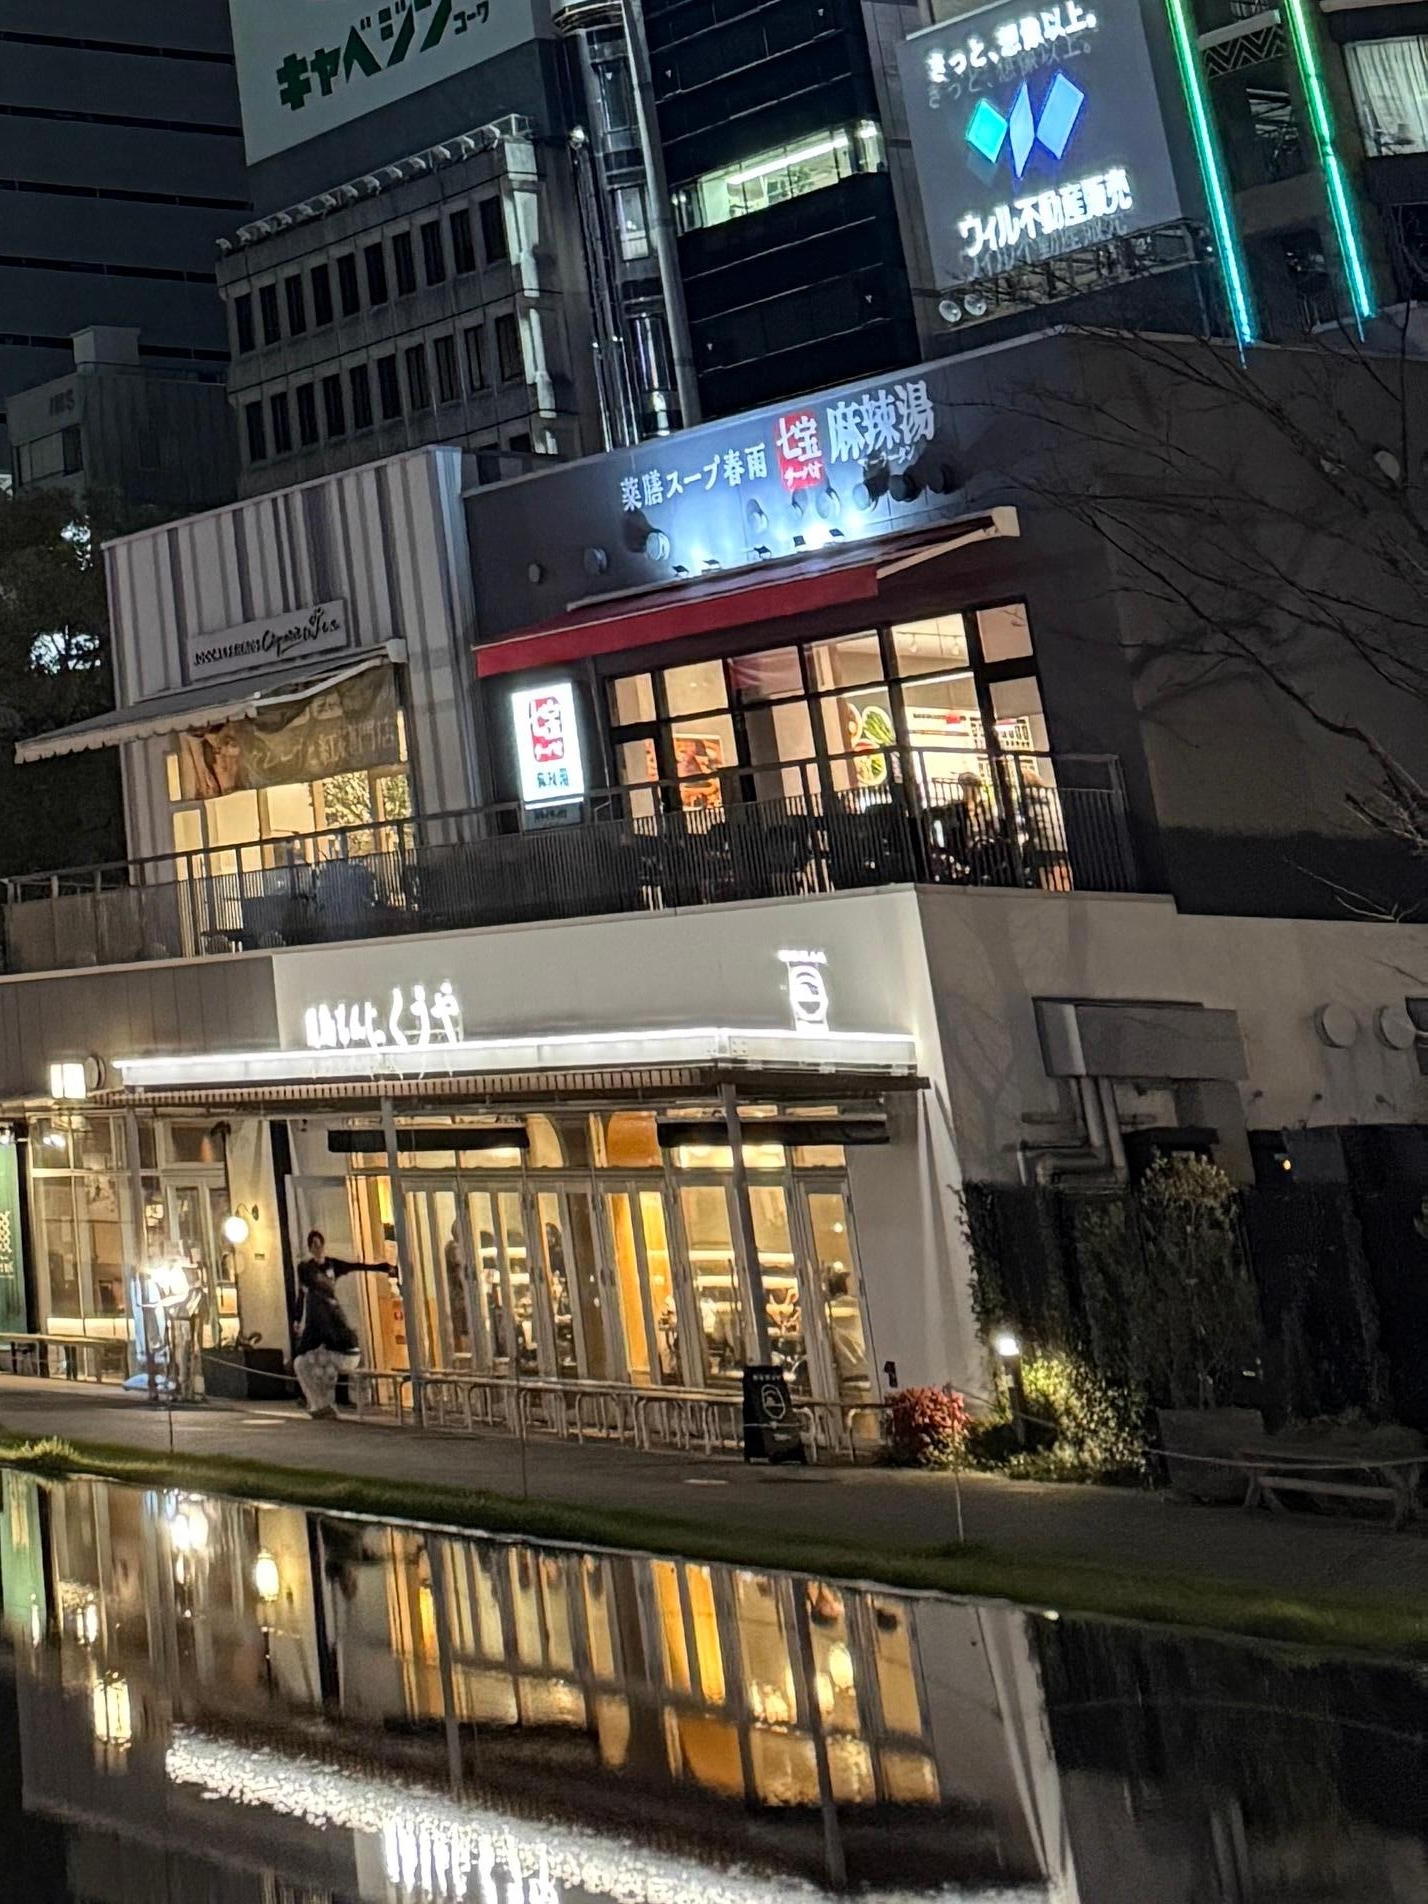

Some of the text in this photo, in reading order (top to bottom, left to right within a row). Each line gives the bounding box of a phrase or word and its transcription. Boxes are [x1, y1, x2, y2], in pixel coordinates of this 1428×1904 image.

[776, 415, 823, 463] 七宝
[826, 380, 935, 464] 麻辣湯
[619, 443, 768, 512] 薬膳スープ春雨
